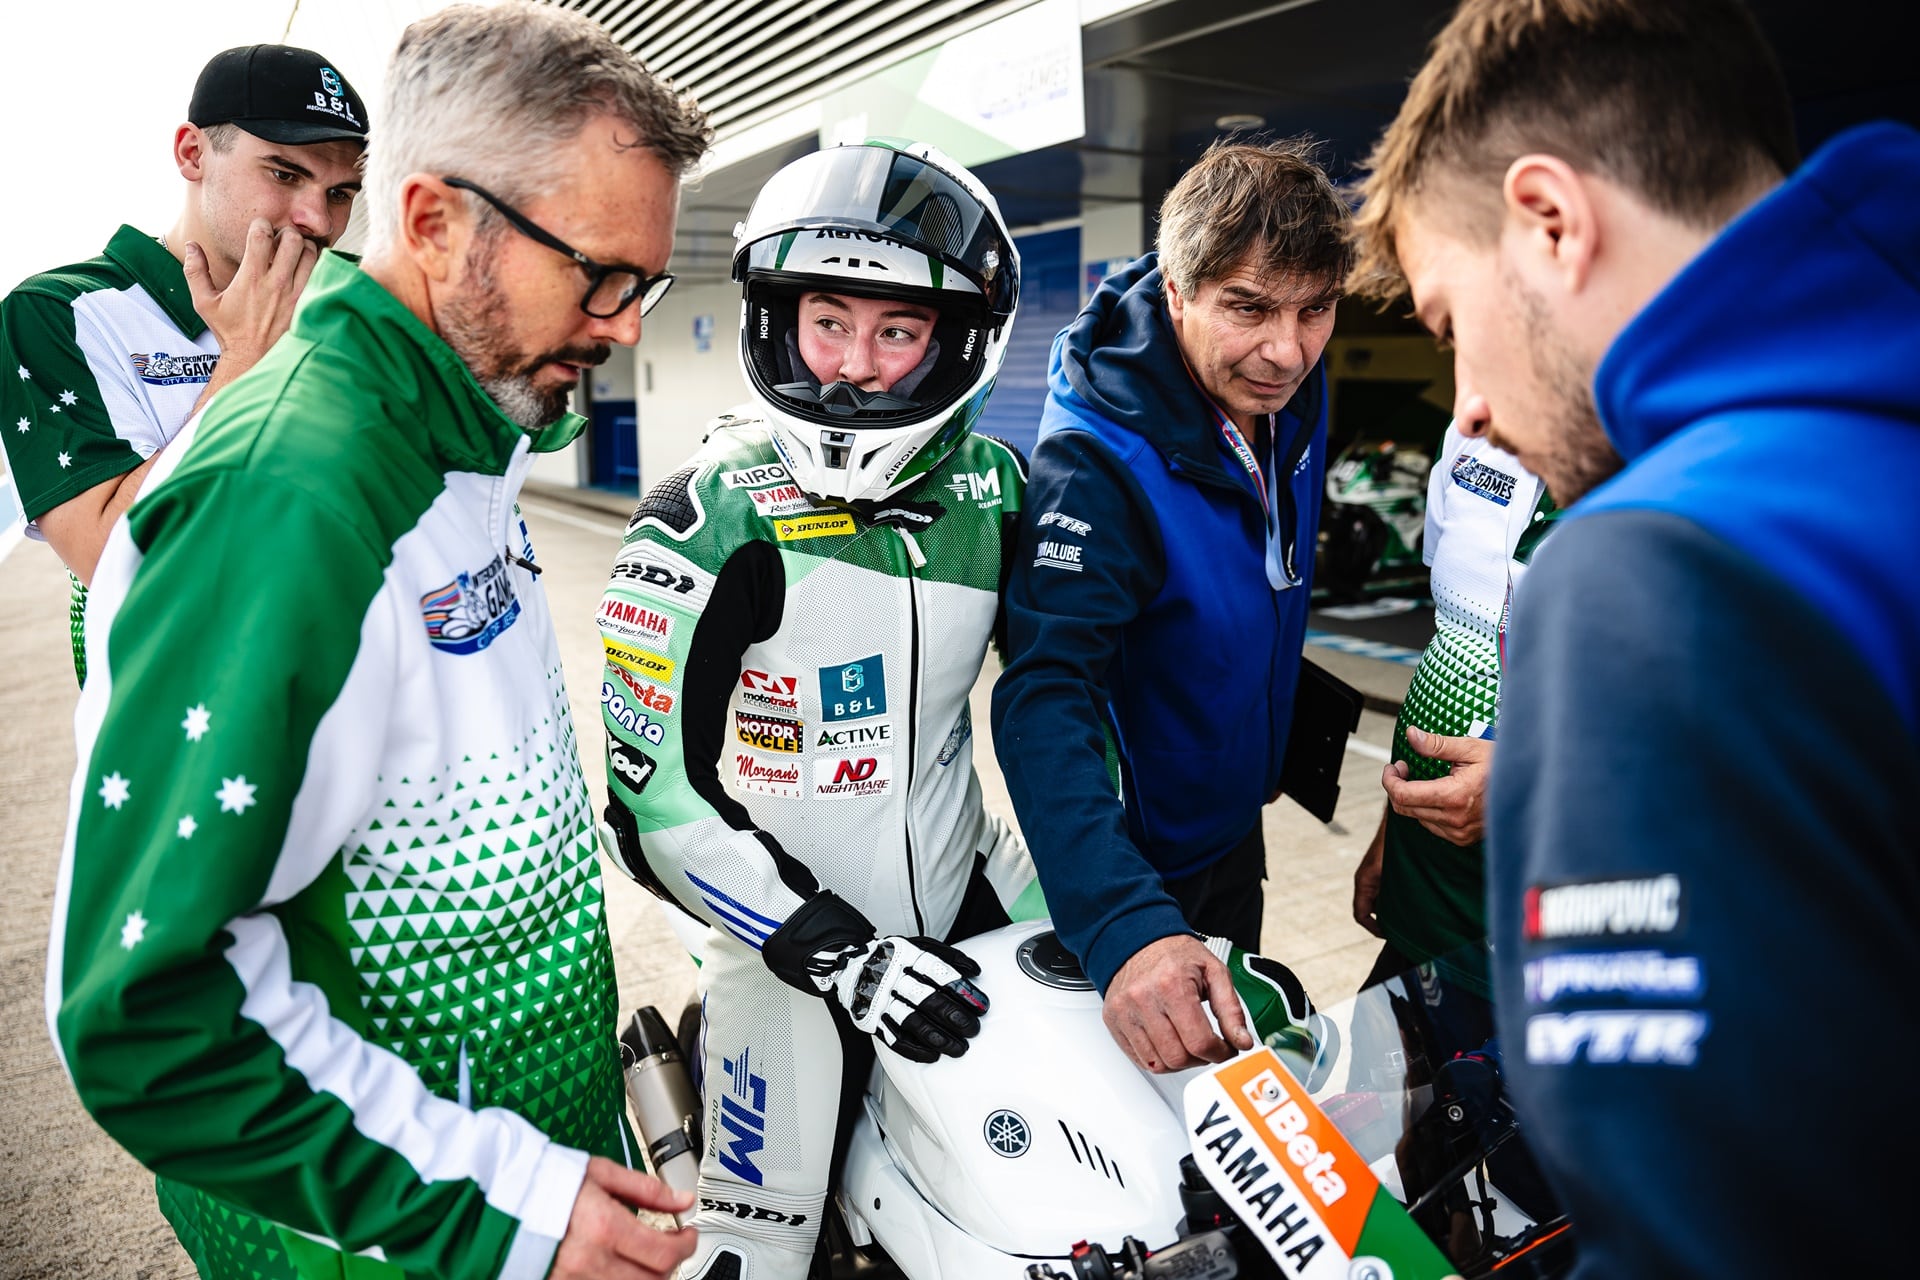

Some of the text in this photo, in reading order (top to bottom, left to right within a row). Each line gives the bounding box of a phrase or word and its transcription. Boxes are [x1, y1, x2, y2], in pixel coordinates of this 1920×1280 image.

[314, 92, 355, 119] B & L
[760, 307, 769, 340] AIROH
[962, 328, 978, 361] AIROH
[885, 446, 918, 481] AIROH
[1235, 446, 1257, 473] GAMES
[766, 486, 804, 503] YAM
[944, 467, 1002, 501] FIM
[1474, 472, 1515, 500] GAMES
[797, 520, 849, 532] DUNLOP
[1037, 511, 1093, 537] GYTR
[605, 600, 668, 636] YAMAHA
[605, 646, 668, 672] DUNLOP
[620, 667, 673, 715] Beta
[743, 692, 799, 710] mototrack
[743, 698, 798, 715] ACCESSORIES
[834, 697, 876, 716] B & L
[737, 718, 796, 741] MOTOR
[739, 730, 795, 751] CYCLE
[816, 724, 891, 747] ACTIVE
[737, 753, 799, 784] Morgan's
[832, 757, 878, 784] ND
[736, 779, 801, 798] CRANES
[816, 779, 891, 794] NIGHTMARE
[855, 789, 883, 797] DESIGNS
[709, 1099, 719, 1158] OCEANIA
[719, 1045, 767, 1187] FIM
[1264, 1099, 1348, 1208] Beta
[1194, 1100, 1325, 1274] YAMAHA
